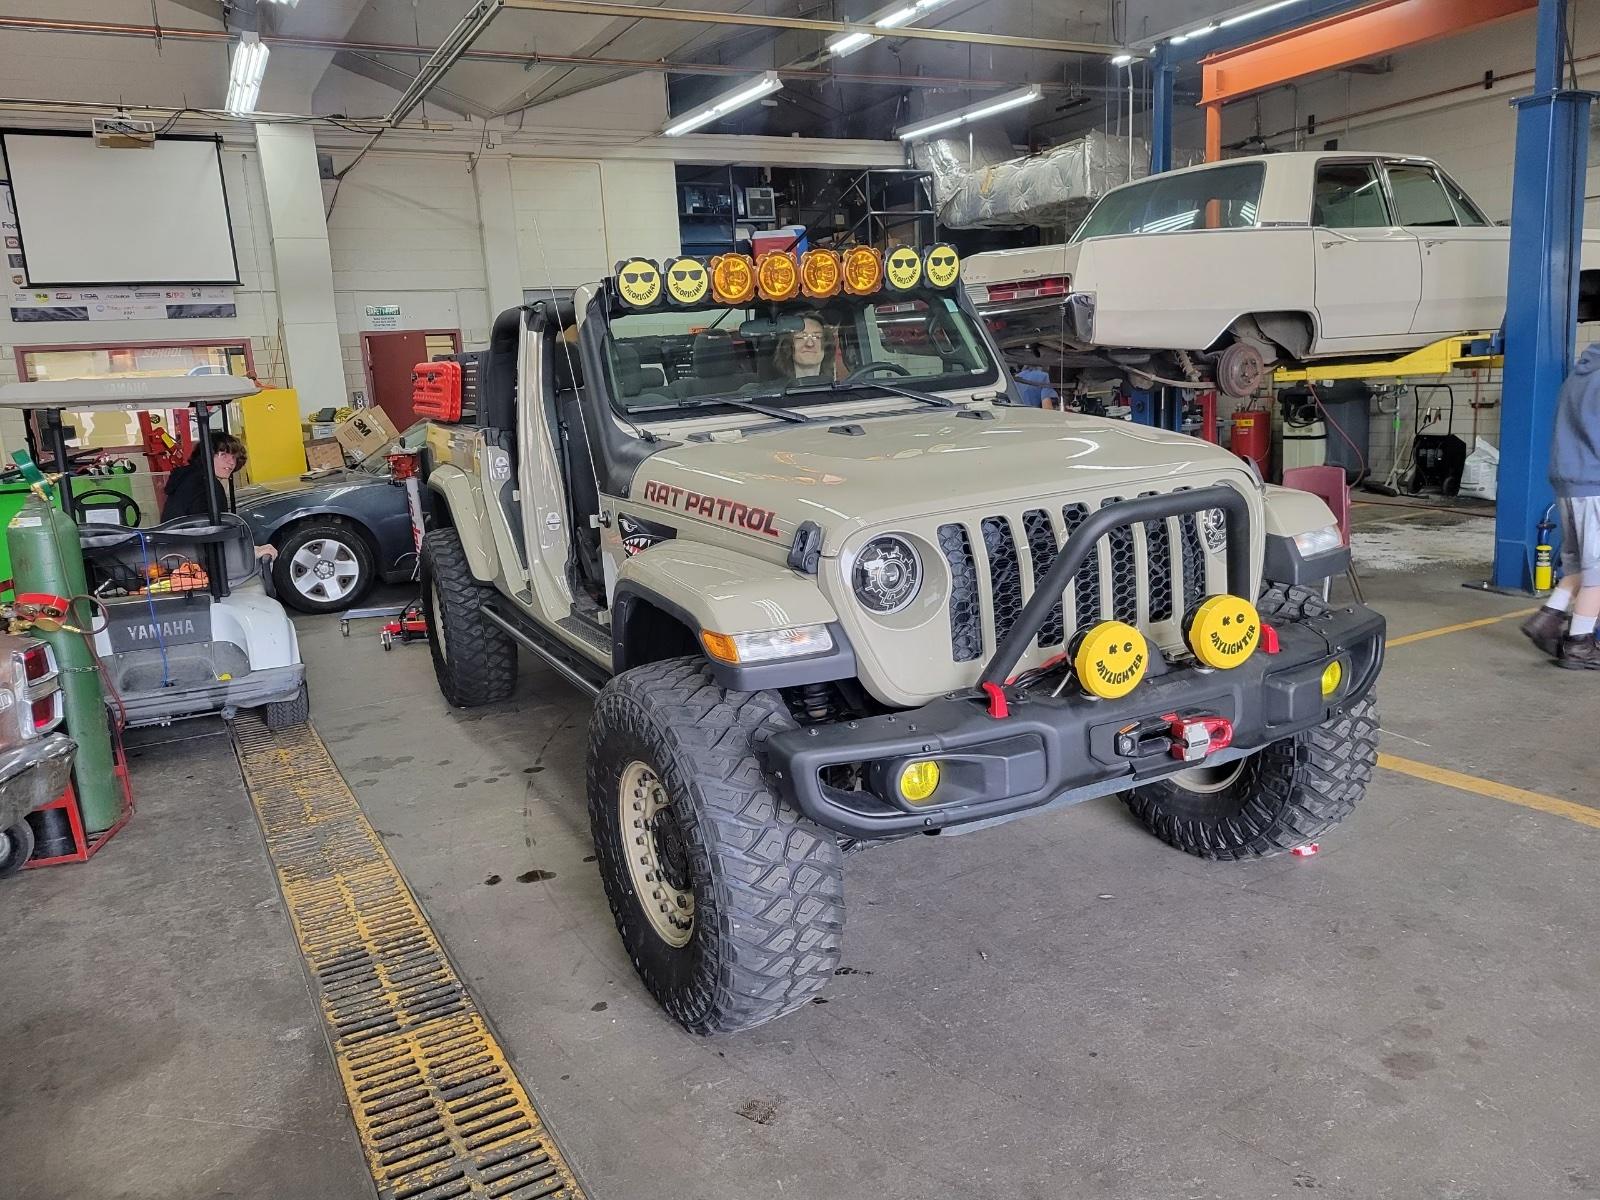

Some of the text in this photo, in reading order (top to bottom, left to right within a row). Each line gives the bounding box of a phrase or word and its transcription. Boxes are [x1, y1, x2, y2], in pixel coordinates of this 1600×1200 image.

[353, 418, 372, 437] 3M
[643, 480, 780, 538] RAT PATROL
[127, 619, 195, 640] YAMAHA
[1210, 624, 1256, 655] DAYLIGHTER
[1095, 653, 1144, 685] DAYLIGHTER
